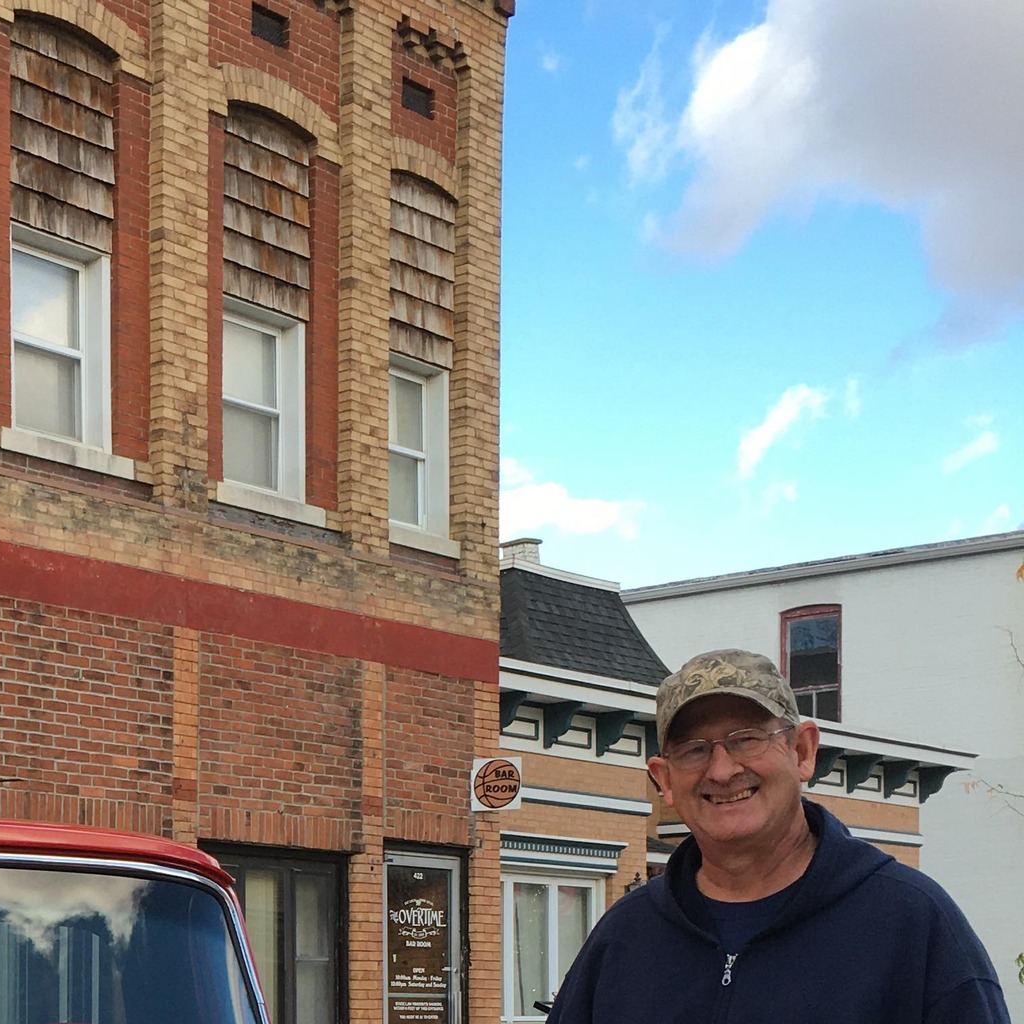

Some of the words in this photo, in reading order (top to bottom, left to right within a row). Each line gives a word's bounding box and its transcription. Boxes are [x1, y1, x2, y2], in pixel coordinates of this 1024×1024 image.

[494, 770, 515, 778] BAR
[485, 784, 517, 793] ROOM
[413, 872, 424, 880] 422
[398, 907, 447, 927] OVERTIME
